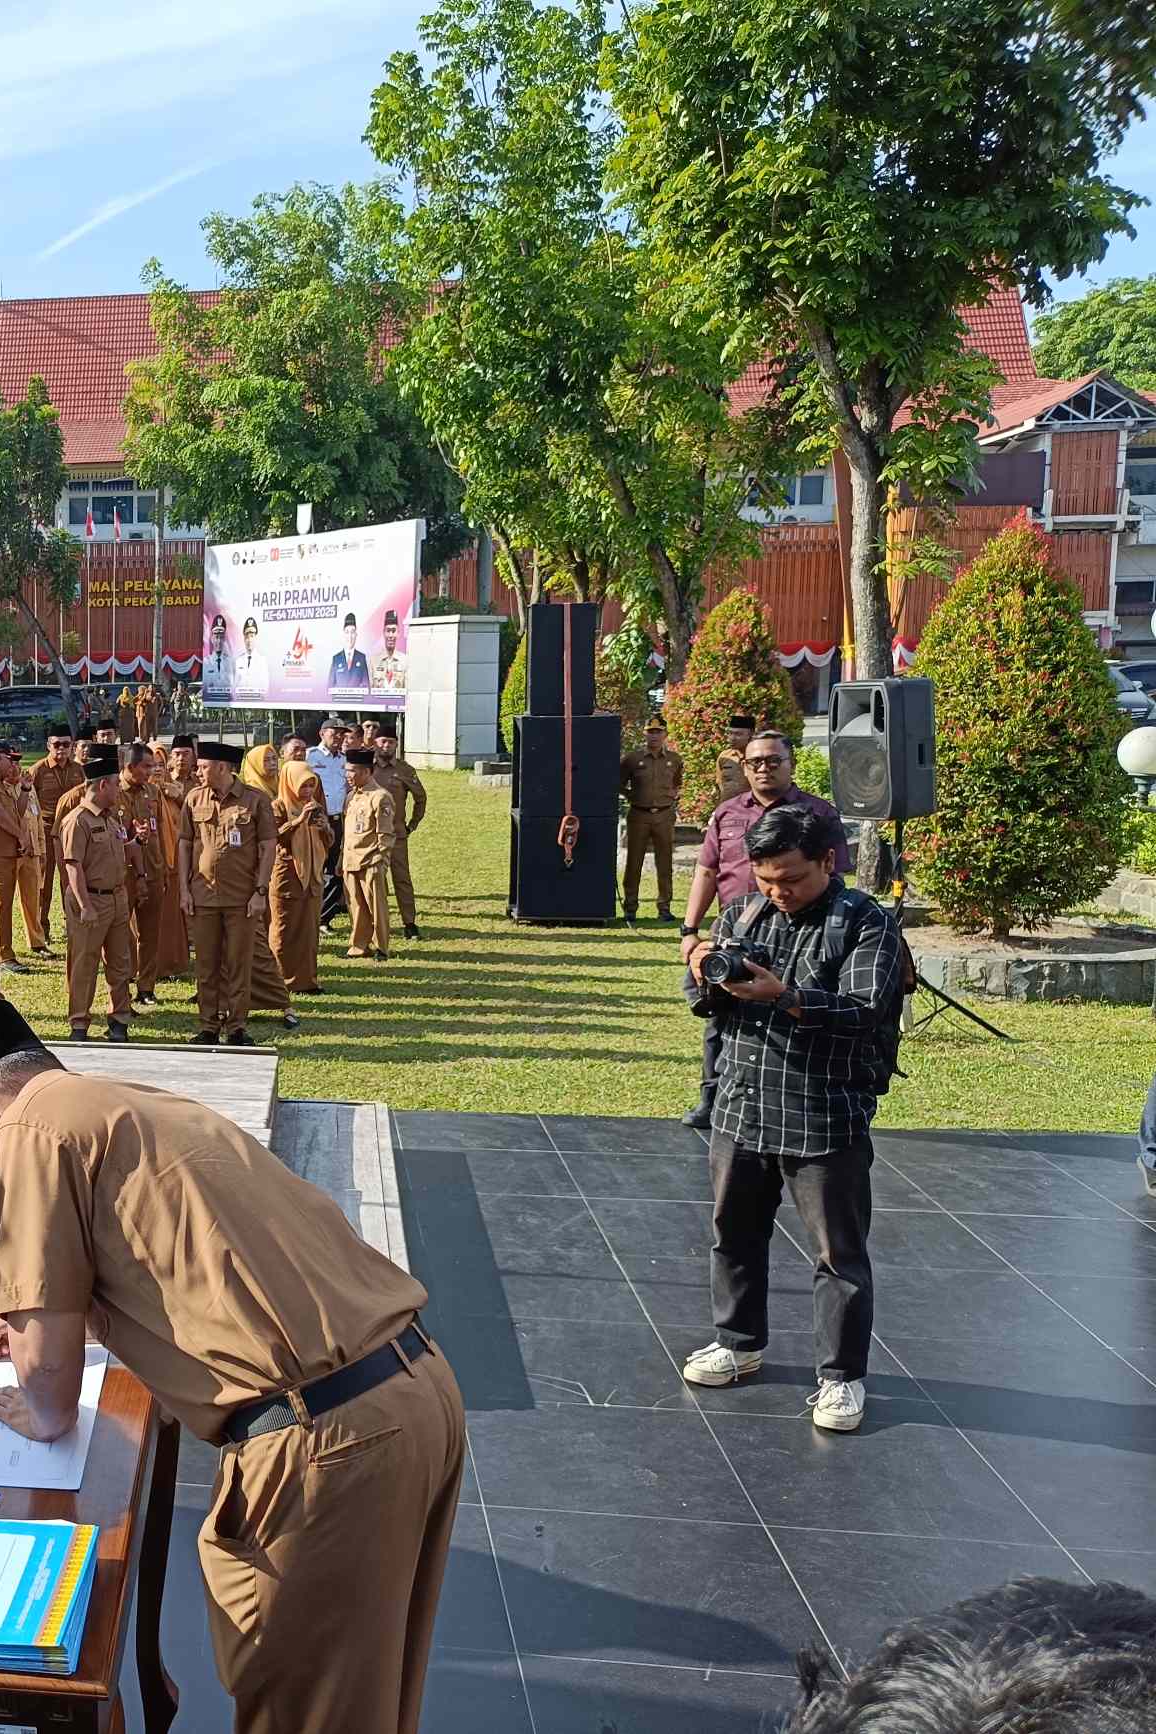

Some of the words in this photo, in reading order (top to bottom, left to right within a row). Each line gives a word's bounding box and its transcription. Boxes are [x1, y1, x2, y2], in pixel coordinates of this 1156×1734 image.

[278, 573, 322, 586] SELAMAT
[88, 581, 120, 593] MAL
[88, 597, 120, 607] KOTA
[124, 595, 200, 607] PEKABARU
[252, 591, 281, 607] HARI
[284, 585, 350, 605] PRAMUKA
[286, 607, 314, 619] TAHUN
